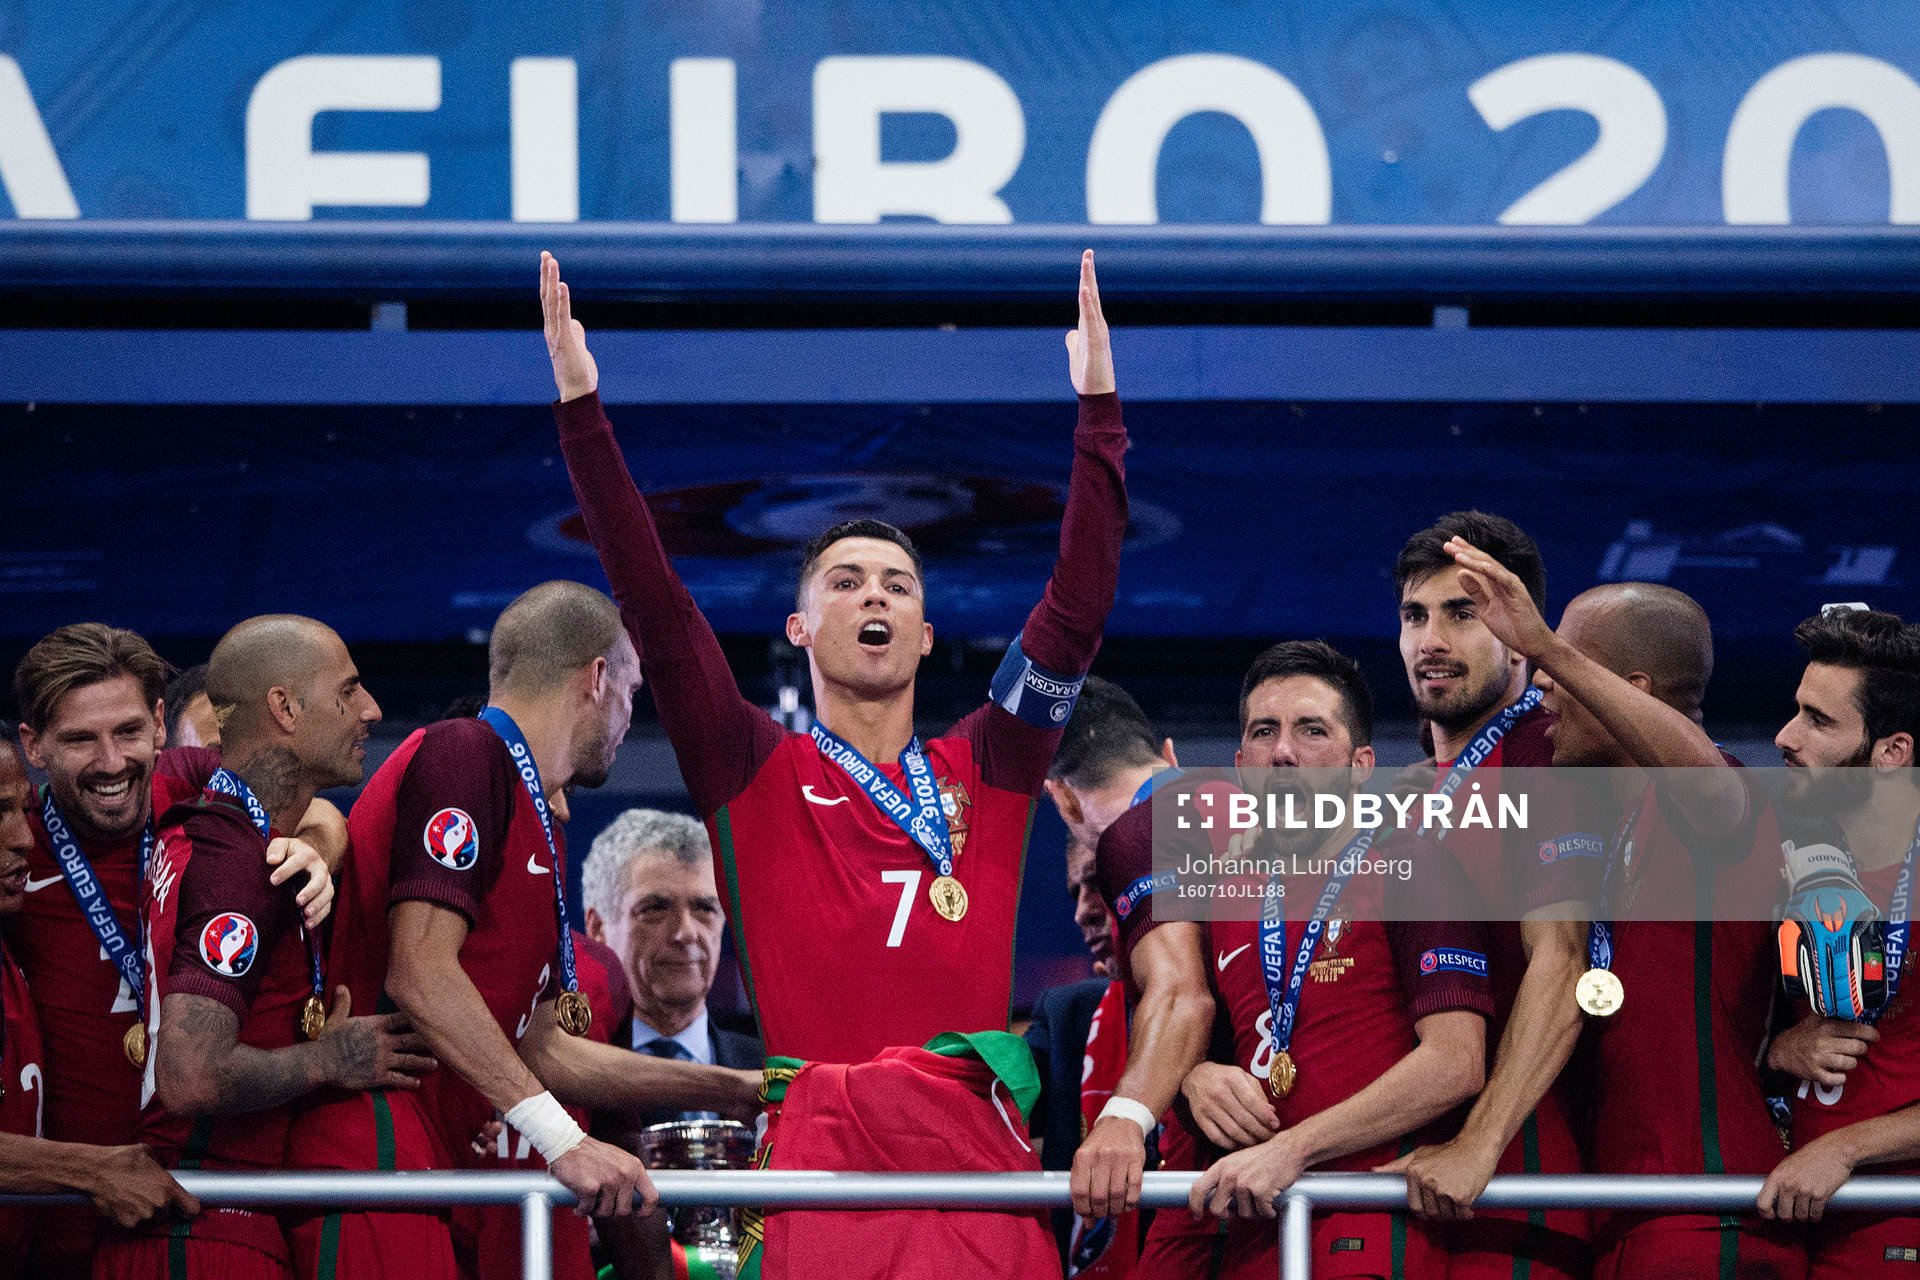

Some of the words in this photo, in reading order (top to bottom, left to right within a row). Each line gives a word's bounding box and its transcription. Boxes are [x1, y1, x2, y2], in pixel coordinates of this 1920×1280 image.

[245, 54, 1333, 224] EURO
[1026, 672, 1071, 695] RACISM
[509, 742, 540, 794] 2016
[811, 726, 844, 759] 2016
[837, 750, 875, 784] EURO
[1457, 725, 1504, 772] UEFA
[869, 776, 911, 820] UEFA
[912, 775, 939, 819] 2016
[60, 844, 97, 899] EURO
[1559, 839, 1603, 854] RESPECT
[881, 870, 922, 948] 7
[1128, 874, 1176, 902] RESPECT
[1308, 881, 1341, 934] EURO
[1890, 869, 1910, 926] EURO
[88, 896, 126, 953] UEFA
[1264, 931, 1281, 982] UEFA
[1291, 937, 1314, 989] 2016
[1439, 953, 1487, 971] RESPECT
[1885, 929, 1905, 984] UEFA
